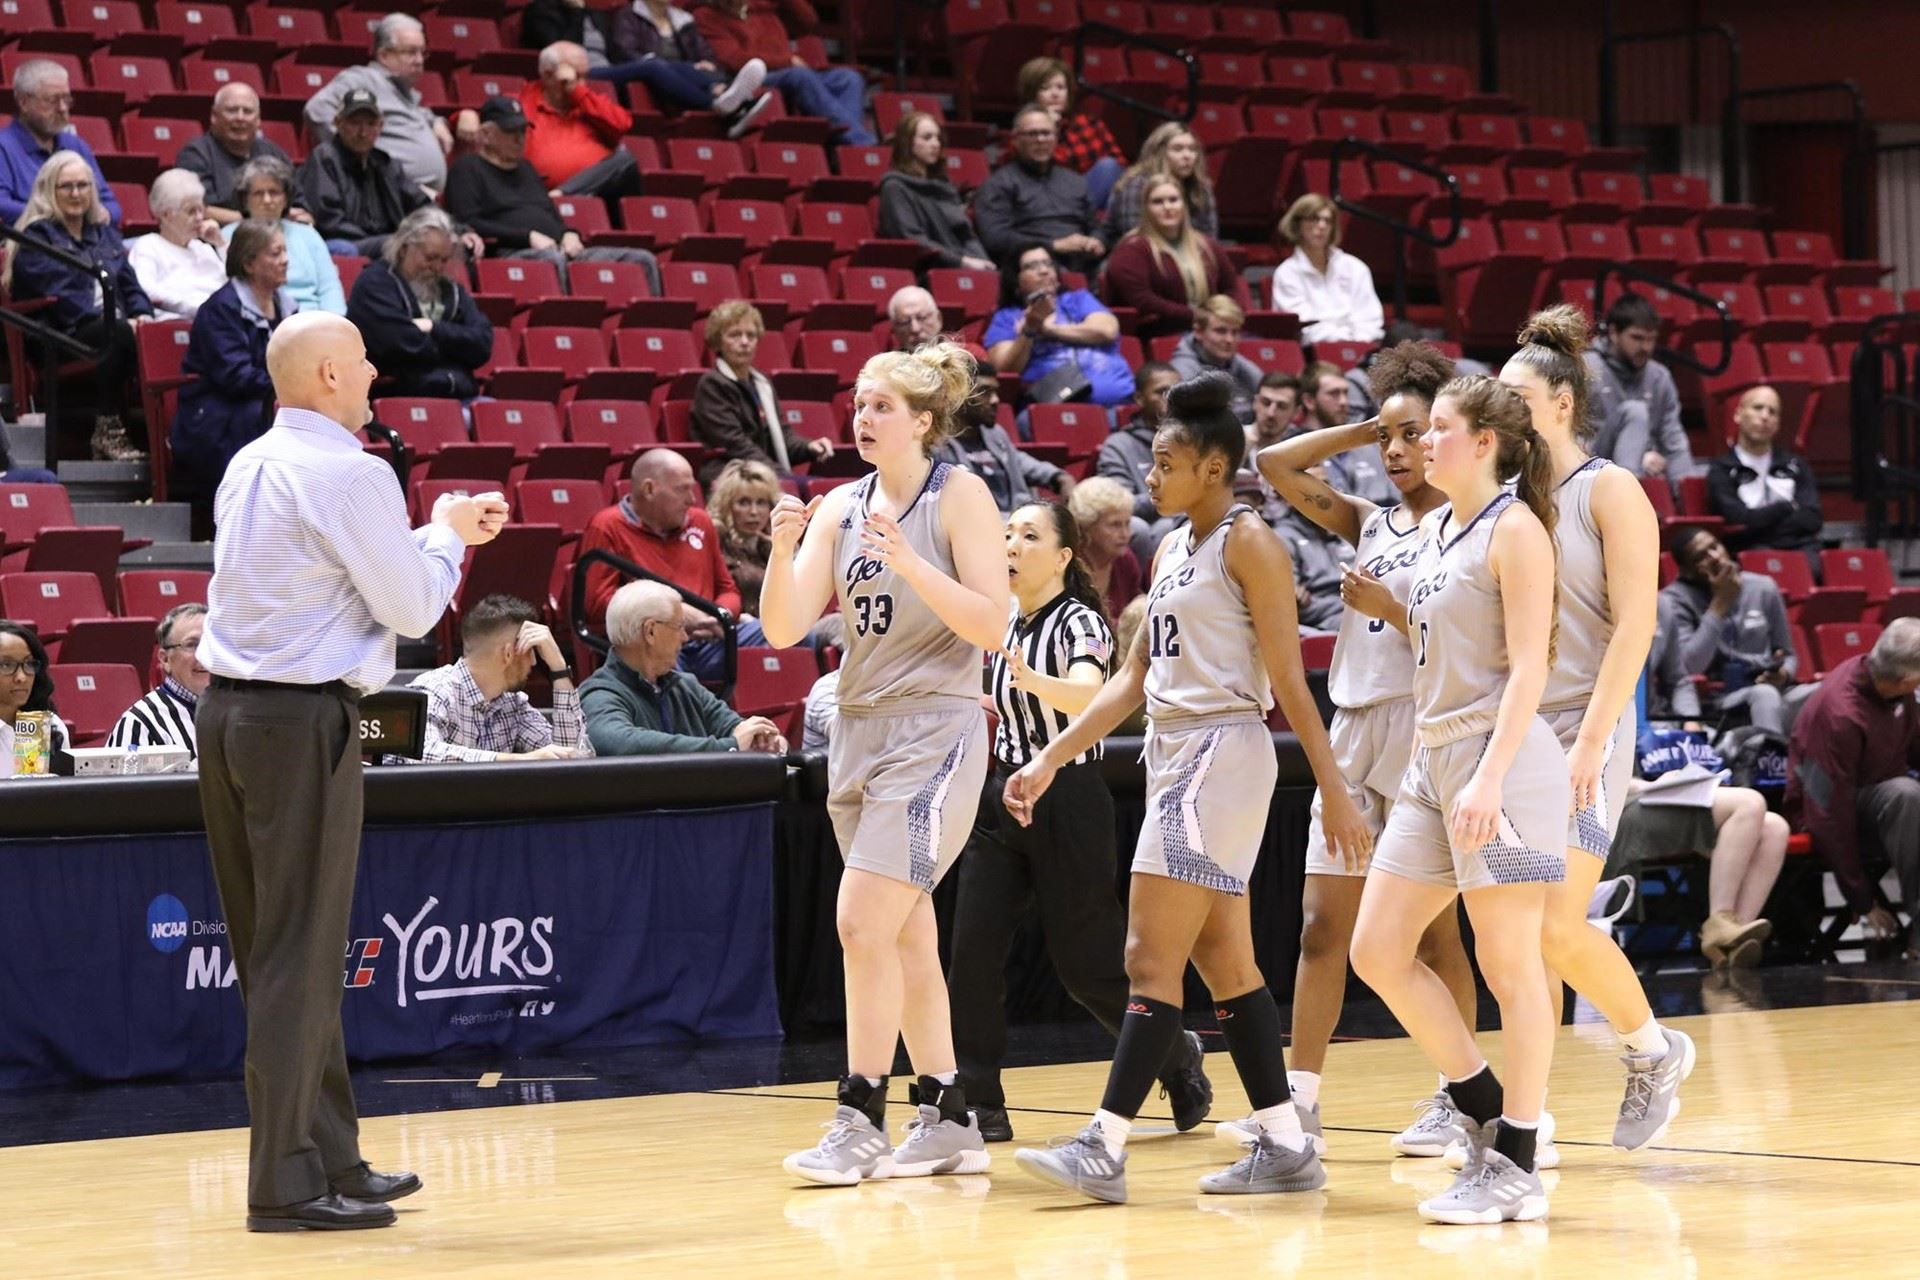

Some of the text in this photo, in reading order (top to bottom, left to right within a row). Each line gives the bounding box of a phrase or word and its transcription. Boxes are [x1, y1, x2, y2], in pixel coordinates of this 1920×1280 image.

[854, 594, 893, 637] 33
[1151, 613, 1180, 657] 12
[16, 720, 36, 734] IBO
[359, 719, 385, 739] SS.
[152, 920, 228, 938] NCAA Divsio
[186, 945, 239, 990] MA
[382, 896, 553, 1007] YOURS
